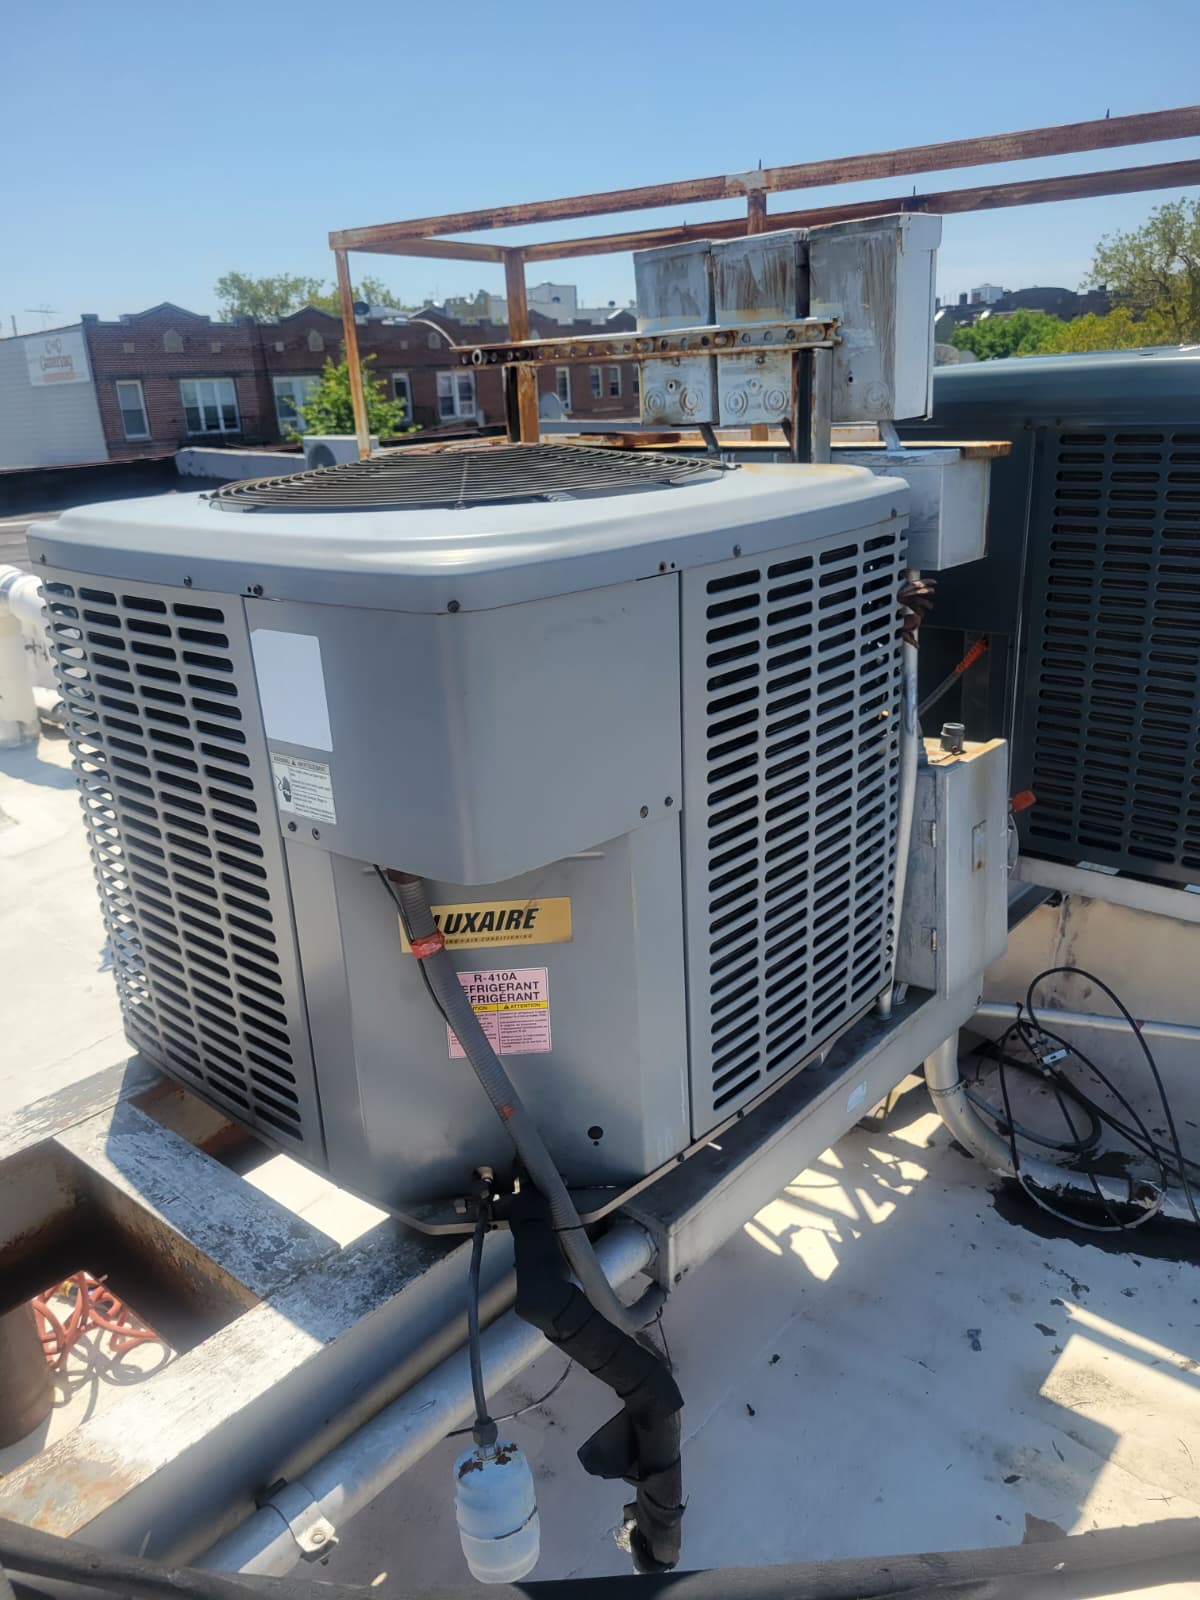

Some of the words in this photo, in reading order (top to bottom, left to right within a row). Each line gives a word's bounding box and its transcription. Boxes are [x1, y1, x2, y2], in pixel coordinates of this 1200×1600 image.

[474, 972, 517, 983] R-410A
[463, 981, 540, 994] EFRIGERANT
[469, 991, 540, 1004] FRIGÉRANT
